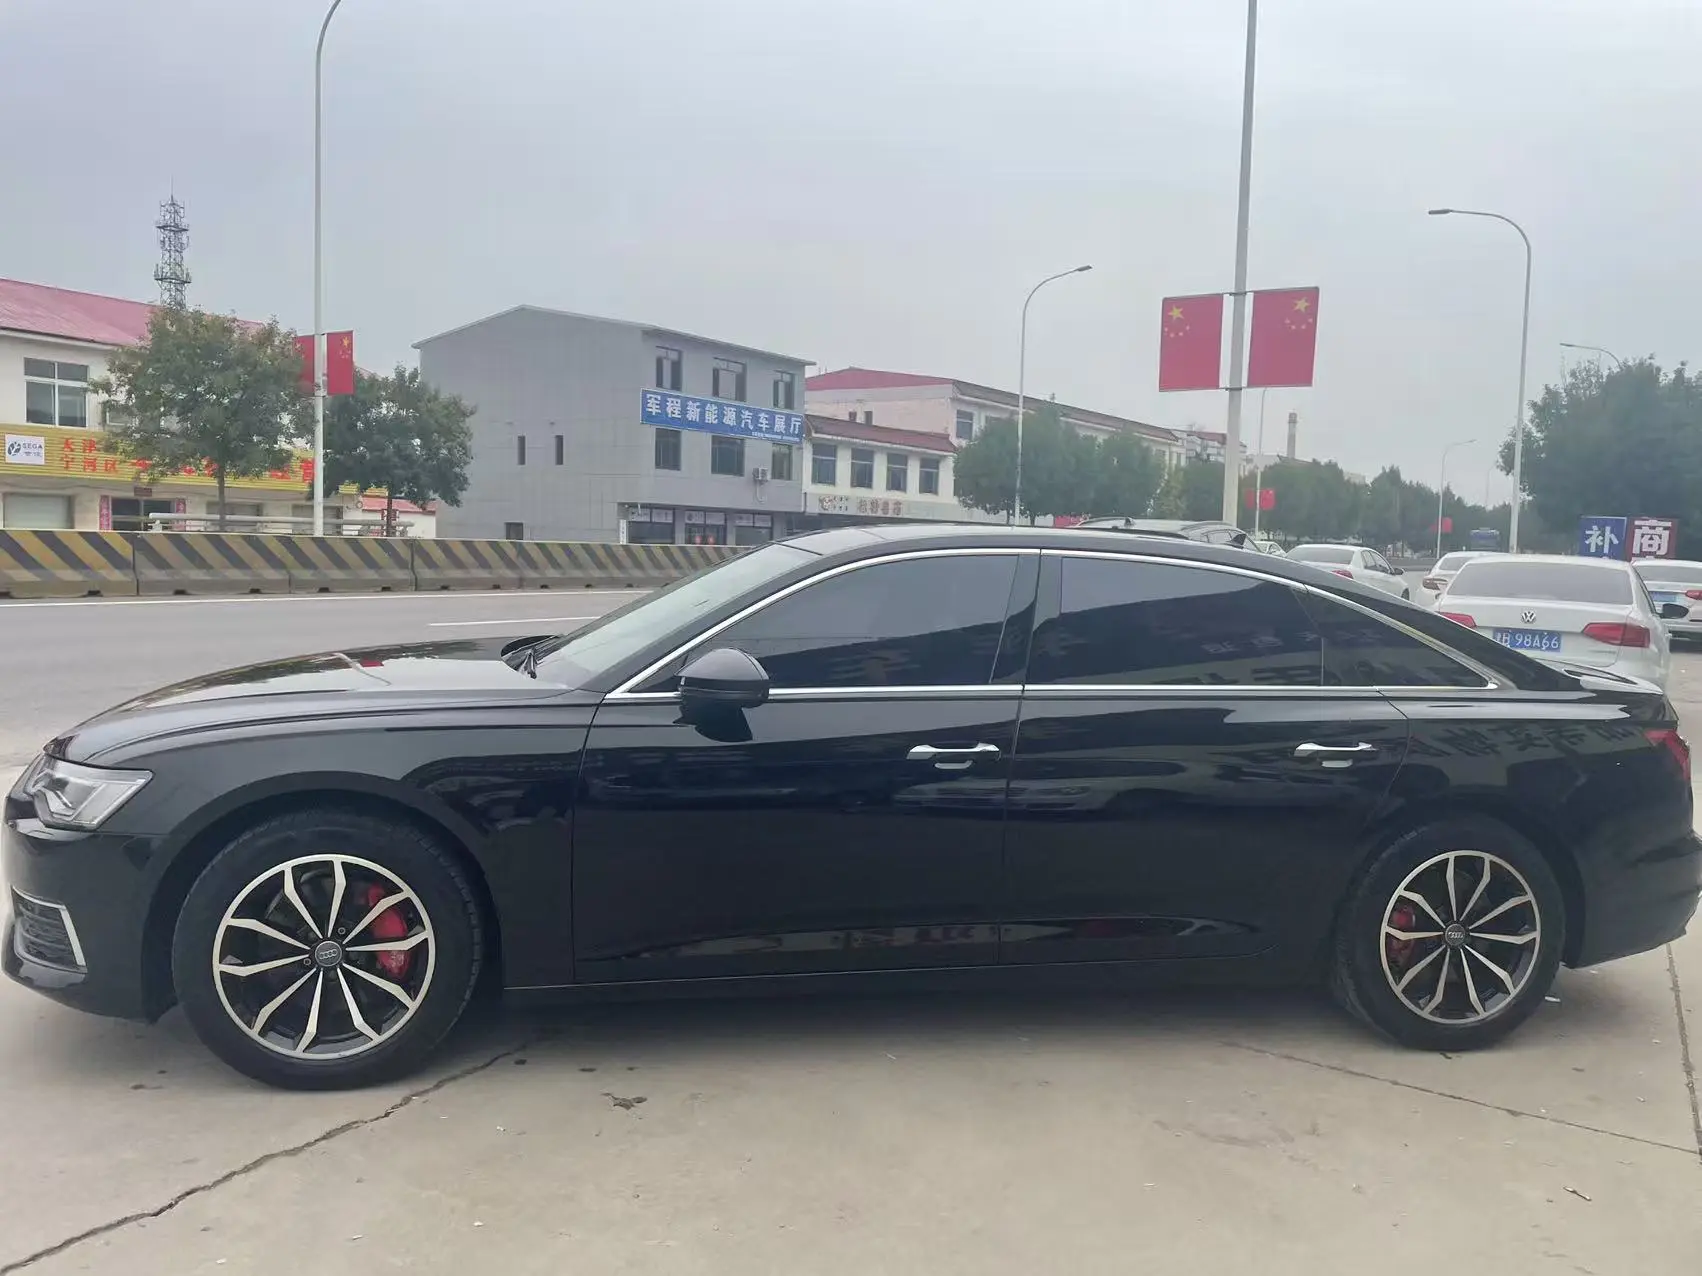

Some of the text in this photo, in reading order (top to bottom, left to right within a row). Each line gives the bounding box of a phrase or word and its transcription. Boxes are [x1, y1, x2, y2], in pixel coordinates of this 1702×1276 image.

[645, 393, 803, 435] 军程新能源汽车展厅
[1584, 525, 1620, 559] 补
[1632, 519, 1673, 559] 商
